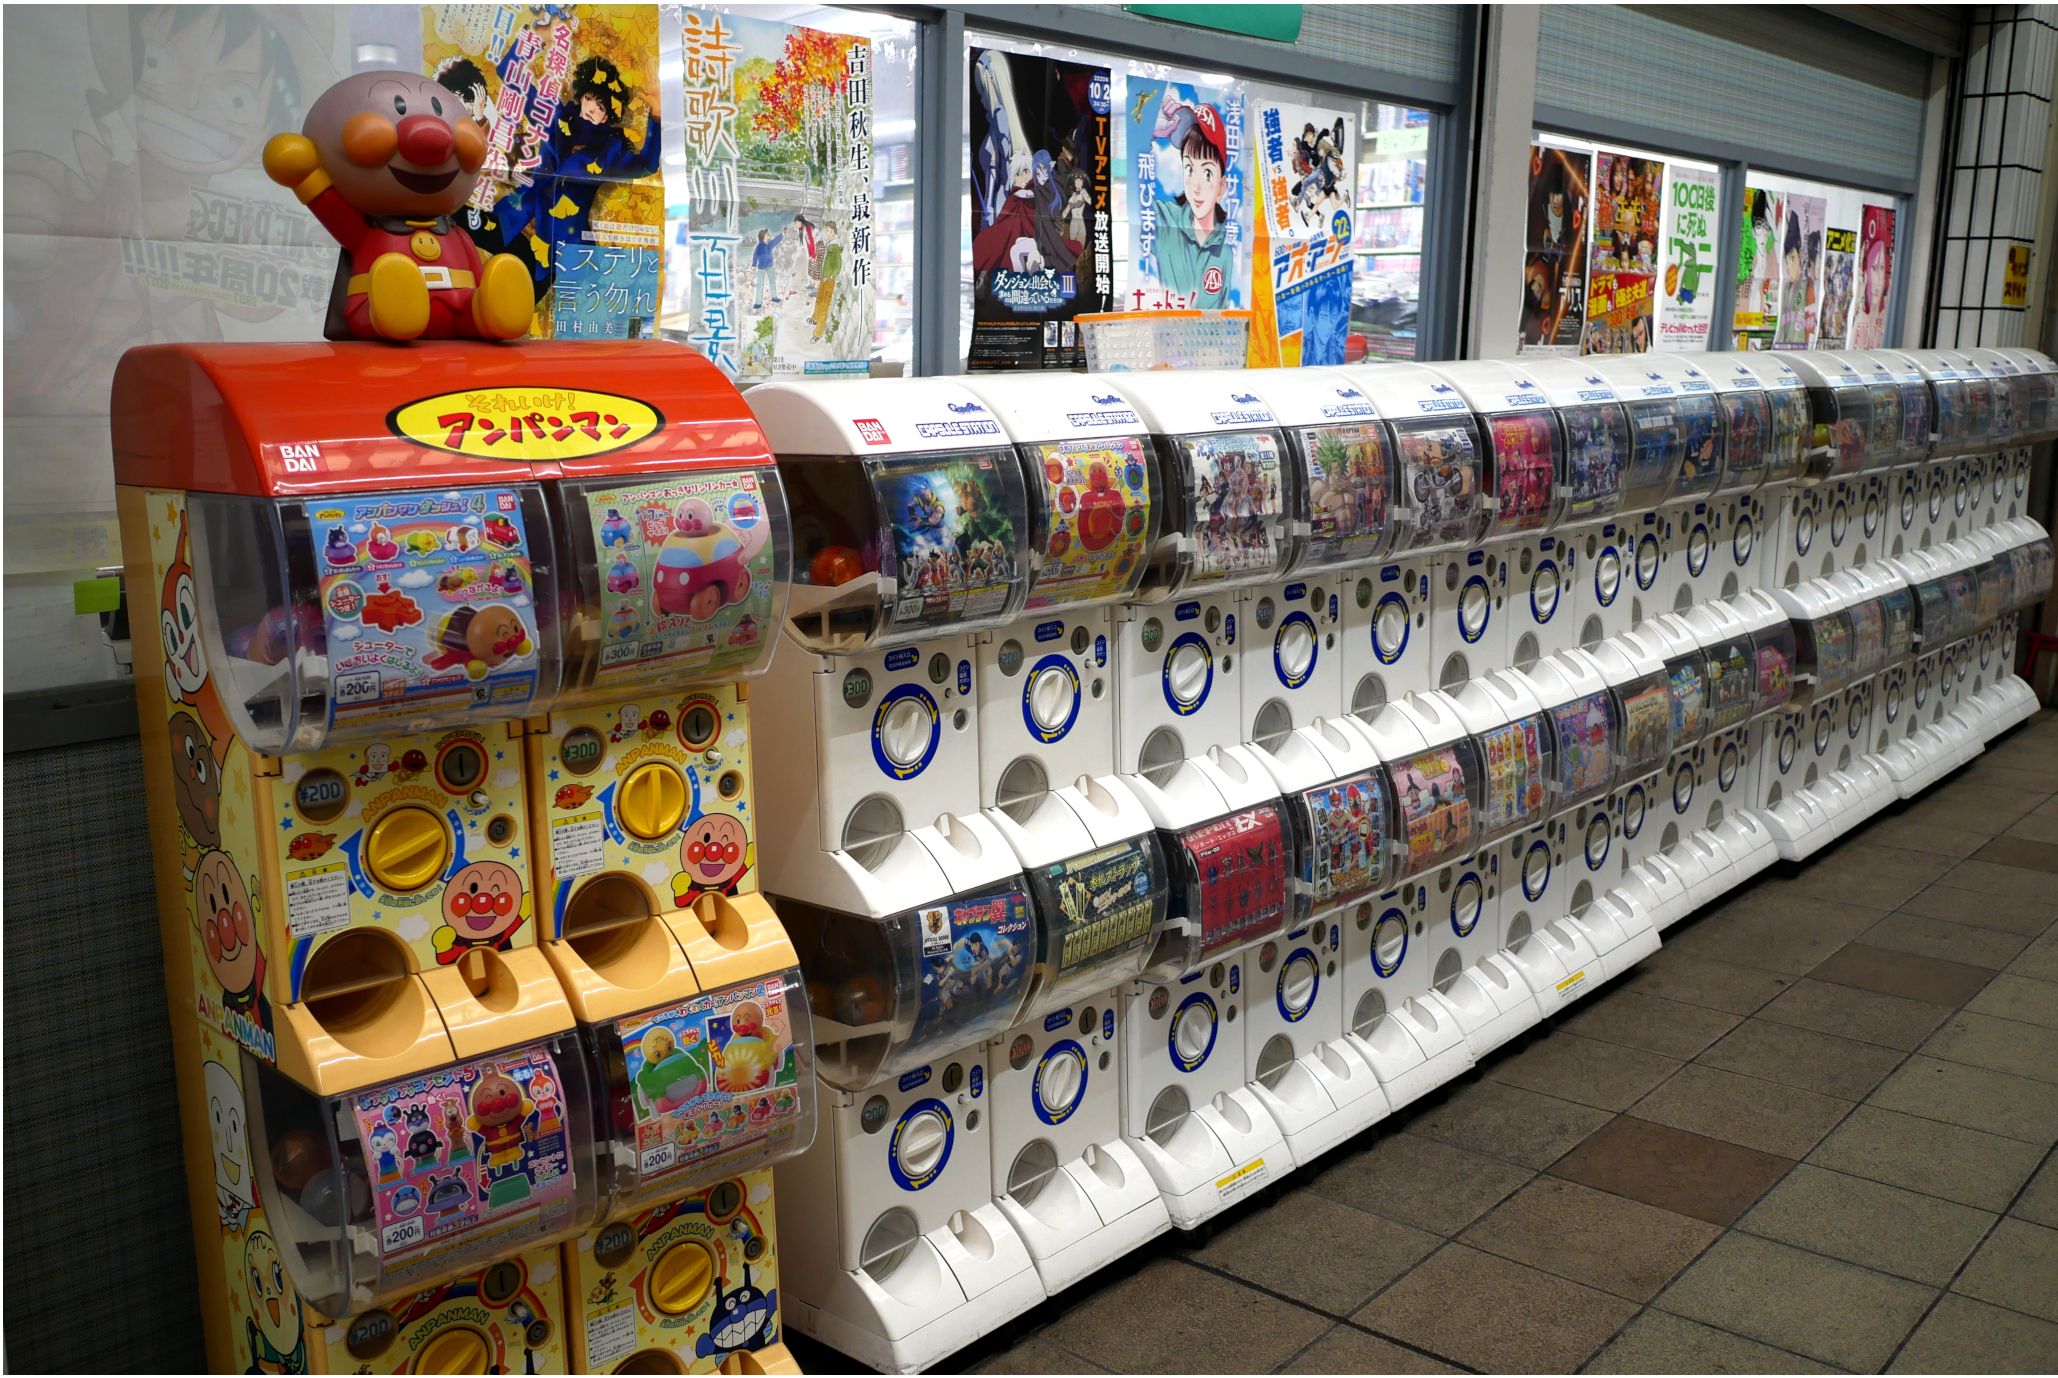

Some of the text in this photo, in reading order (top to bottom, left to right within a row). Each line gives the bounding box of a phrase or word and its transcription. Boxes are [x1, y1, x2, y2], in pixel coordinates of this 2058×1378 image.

[1195, 105, 1218, 133] ASA
[1262, 107, 1285, 165] 強者
[1672, 181, 1717, 213] 100日後
[1677, 211, 1708, 239] に死ぬ
[554, 240, 659, 278] ミステリと
[1273, 233, 1346, 290] アオアシ
[553, 279, 657, 315] 言う勿れ
[556, 319, 614, 335] 田村由美
[466, 392, 576, 413] それいけ!
[438, 410, 632, 450] アンパンマン
[857, 421, 883, 433] BAN
[863, 430, 886, 443] DAI
[279, 444, 321, 460] BAN
[285, 458, 318, 473] DAI
[498, 495, 514, 503] BAN
[499, 502, 513, 510] DAI
[376, 573, 391, 582] おす!
[460, 583, 504, 597] つながるよ!
[353, 640, 415, 657] シューターで
[958, 664, 970, 672] コイン
[563, 741, 598, 761] ¥300
[615, 743, 688, 777] ANPANMAN
[299, 781, 341, 804] ¥200
[361, 785, 449, 823] ANPANMAN
[1234, 809, 1263, 834] EX
[997, 921, 1027, 936] コレクション
[198, 991, 275, 1063] ANPANMAN
[707, 1039, 725, 1069] ピカッ
[386, 1225, 421, 1246] 各200円
[646, 1222, 715, 1262] ANPANMAN
[408, 1306, 490, 1352] ANPANMAN
